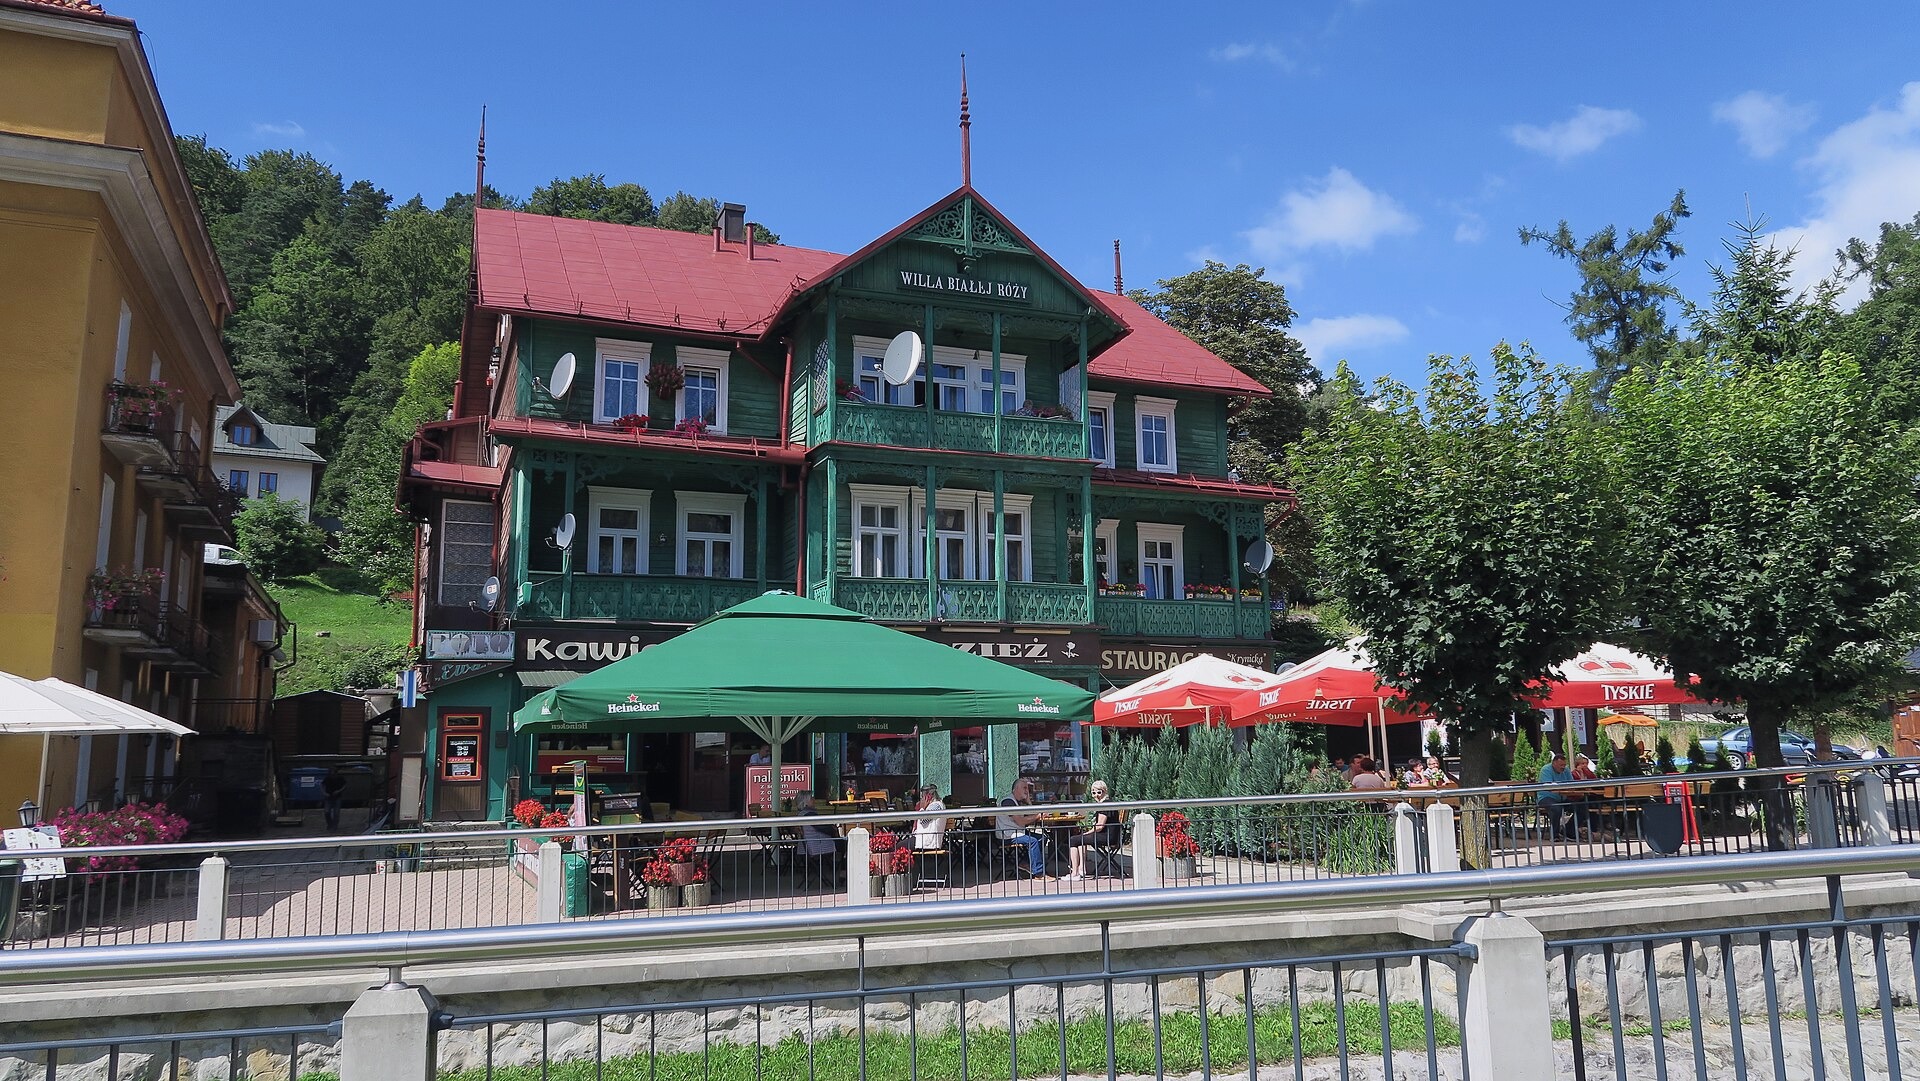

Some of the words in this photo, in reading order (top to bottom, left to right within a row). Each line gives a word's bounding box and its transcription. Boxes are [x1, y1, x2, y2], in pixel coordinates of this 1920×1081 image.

[900, 271, 943, 289] WILLA
[997, 282, 1028, 299] RÓŻY
[526, 635, 659, 661] Kawi
[952, 637, 1048, 658] ZIEŻ
[1258, 687, 1282, 707] TYSKIE
[1601, 683, 1655, 700] TYSKIE
[607, 702, 660, 714] Heineken
[1018, 703, 1060, 714] Heineken
[1114, 697, 1143, 714] TYSKIE
